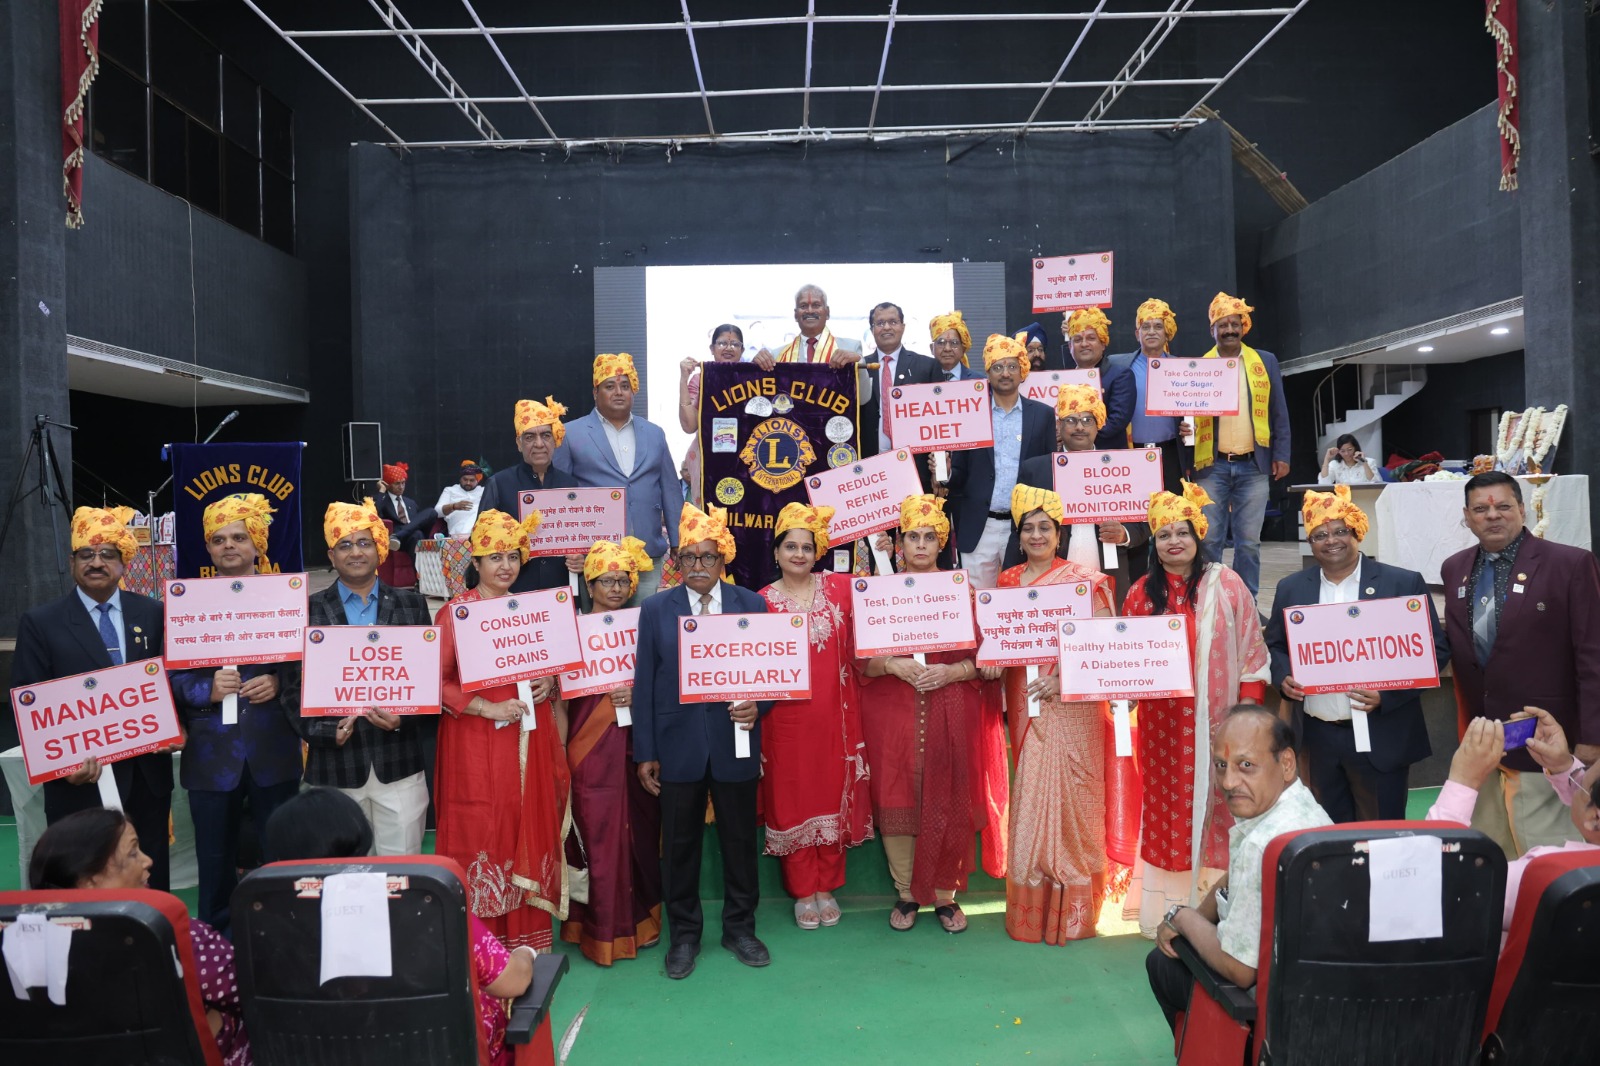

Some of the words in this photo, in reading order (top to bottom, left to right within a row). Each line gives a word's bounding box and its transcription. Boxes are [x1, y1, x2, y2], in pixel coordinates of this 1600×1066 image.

[1069, 273, 1077, 281] को
[711, 378, 776, 412] LIONS
[790, 381, 850, 414] CLUB
[1028, 386, 1059, 399] AVO
[895, 397, 982, 418] HEALTHY
[758, 420, 801, 438] LIONS
[920, 423, 962, 440] DIET
[765, 438, 792, 468] L
[755, 470, 799, 485] INTERNATIONAL
[1084, 466, 1130, 478] BLOOD
[184, 464, 240, 501] LIONS
[247, 464, 294, 500] CLUB
[838, 471, 887, 494] REDUCE
[1085, 484, 1132, 496] SUGAR
[846, 489, 889, 510] REFINE
[1067, 500, 1150, 513] MONITORING
[559, 506, 566, 514] को
[568, 506, 583, 514] रोकने
[593, 505, 605, 514] लिए
[729, 512, 773, 528] ILWAR
[546, 535, 553, 543] को
[579, 534, 589, 542] लिए
[864, 598, 889, 607] Test,
[892, 595, 920, 605] Don't
[170, 614, 195, 626] मधुमेह
[198, 613, 206, 622] के
[210, 612, 222, 622] बारे
[235, 610, 275, 620] जागरूकता
[480, 611, 550, 632] CONSUME
[868, 616, 886, 625] Get
[890, 612, 939, 624] Screened
[943, 611, 960, 620] For
[997, 610, 1023, 623] मधुमेह
[1026, 608, 1038, 618] को
[174, 636, 196, 645] स्वस्थ
[200, 633, 221, 643] जीवन
[225, 632, 235, 642] की
[238, 631, 252, 641] ओर
[256, 630, 275, 640] कदम
[893, 631, 939, 642] Diabetes
[983, 625, 1010, 639] मधुमेह
[1014, 624, 1025, 634] को
[1028, 621, 1057, 633] नियंत्रि
[493, 631, 544, 650] WHOLE
[588, 629, 637, 651] QUIT
[1000, 639, 1032, 650] नियंत्रण
[1035, 638, 1043, 648] में
[1046, 636, 1058, 648] जी
[1064, 643, 1104, 653] Healthy
[1109, 641, 1143, 650] Habits
[1148, 640, 1183, 649] Today,
[350, 646, 402, 661] LOSE
[691, 641, 797, 659] EXCERCISE
[1298, 633, 1424, 666] MEDICATIONS
[495, 649, 549, 669] GRAINS
[1080, 661, 1088, 670] A
[1092, 660, 1140, 669] Diabetes
[1144, 659, 1168, 667] Free
[342, 666, 409, 681] EXTRA
[688, 669, 801, 686] REGULARLY
[482, 679, 499, 687] LIONS
[1098, 678, 1154, 687] Tomorrow
[335, 686, 415, 702] WEIGHT
[30, 682, 159, 731] MANAGE
[44, 714, 159, 761] STRESS
[56, 766, 76, 777] LIONS
[134, 743, 159, 755] PARTAP
[1383, 867, 1419, 879] GUEST
